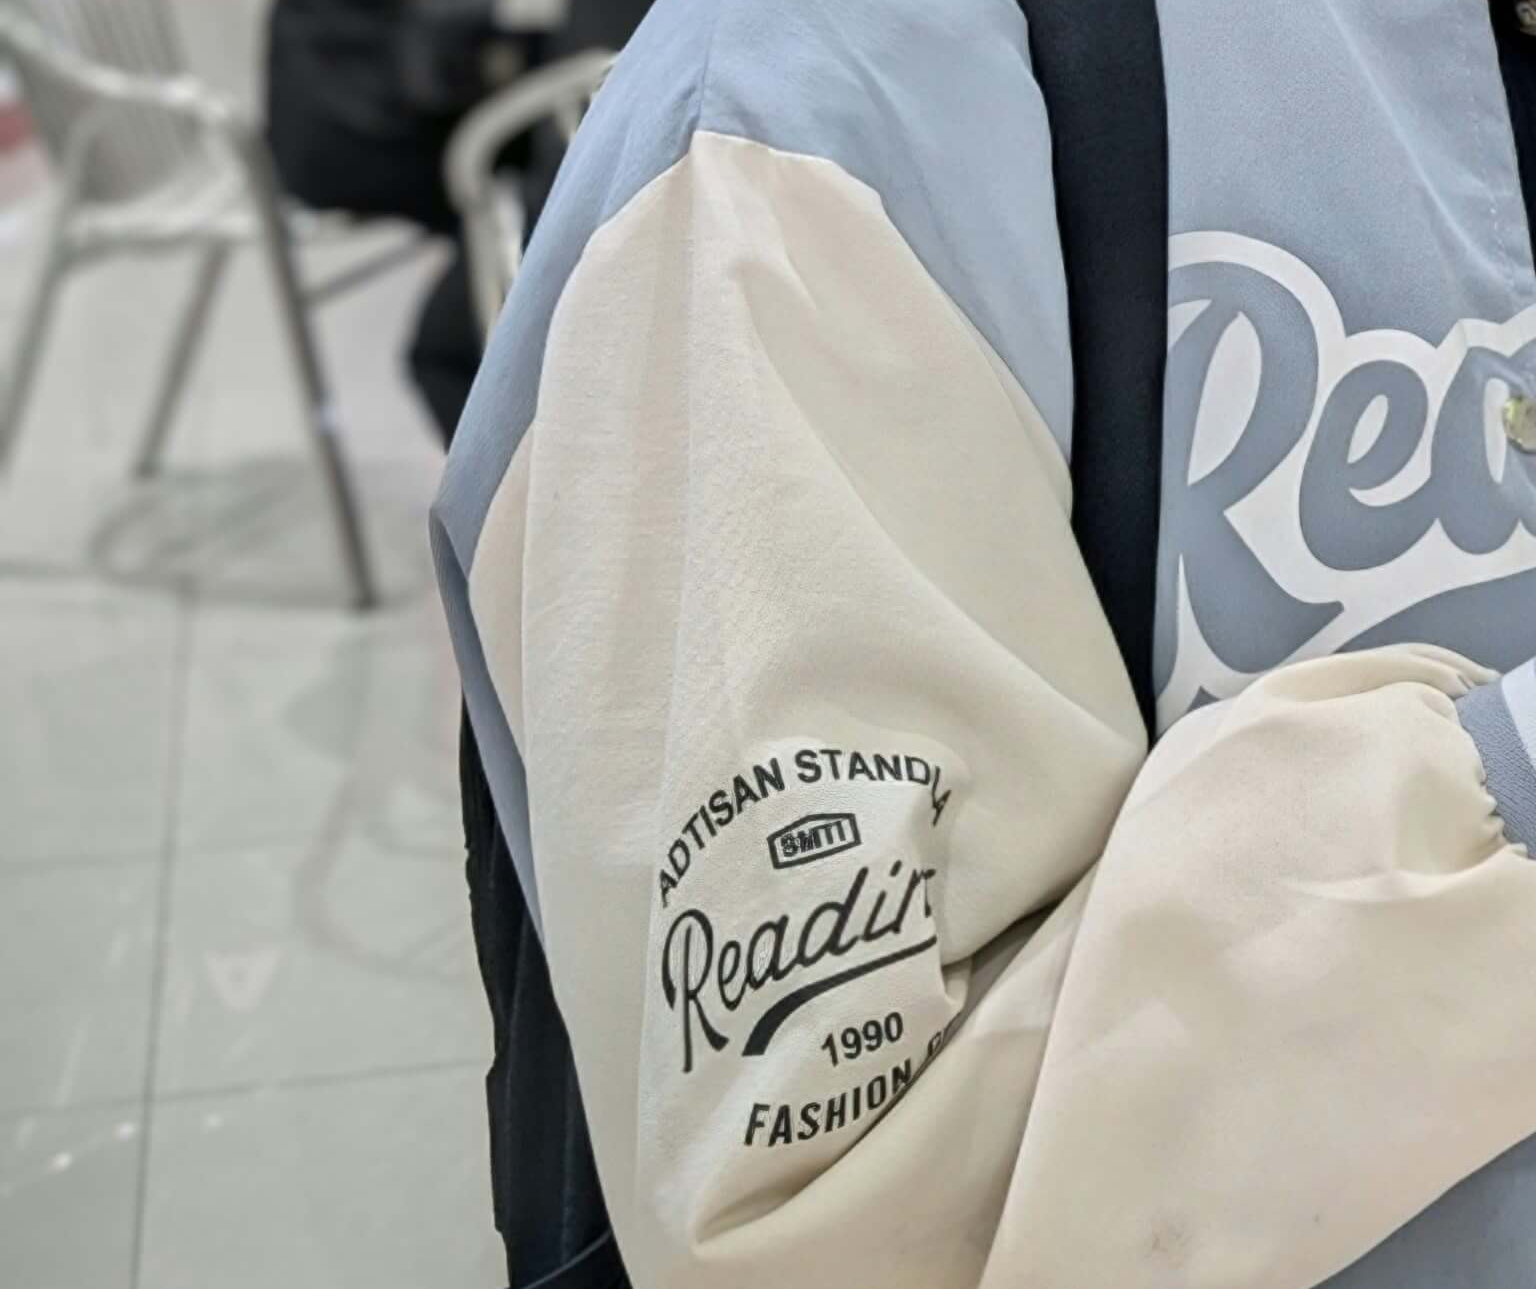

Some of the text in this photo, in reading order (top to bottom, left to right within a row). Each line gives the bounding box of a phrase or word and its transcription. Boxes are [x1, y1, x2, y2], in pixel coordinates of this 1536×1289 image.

[795, 748, 952, 827] STAND
[661, 859, 937, 1074] Readin
[820, 1010, 905, 1068] 1990
[743, 1057, 914, 1147] FASHION
